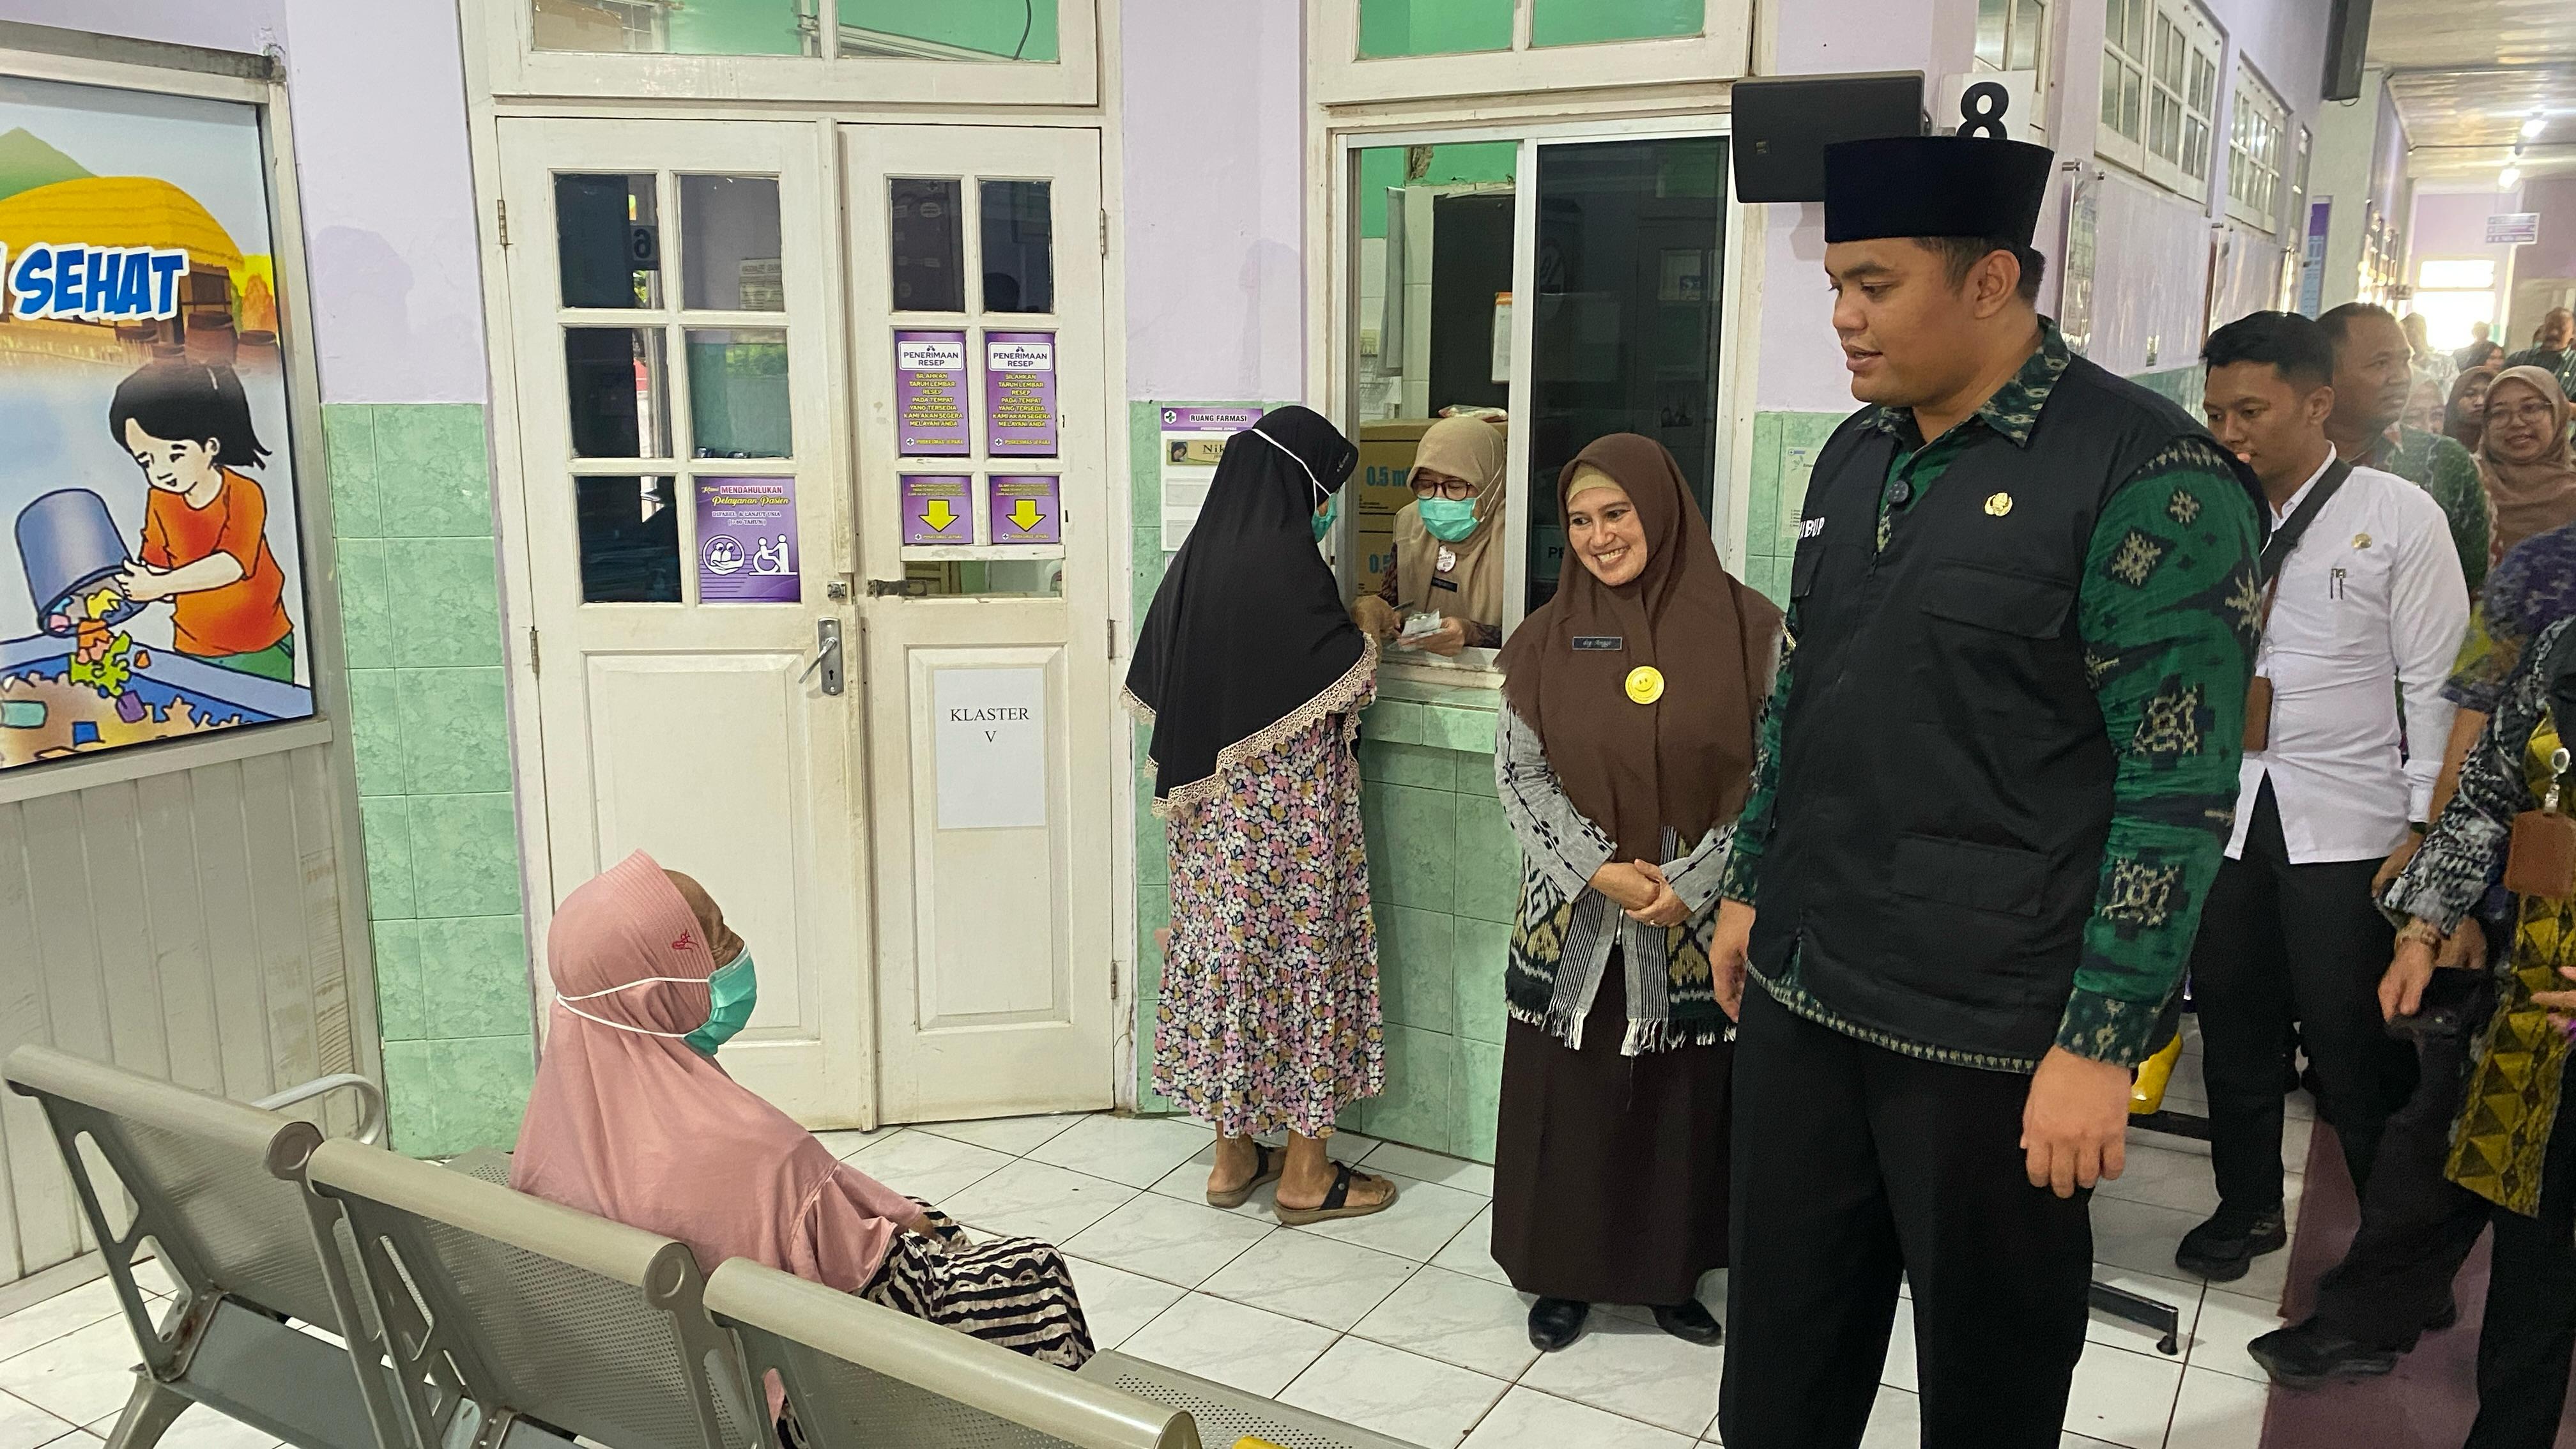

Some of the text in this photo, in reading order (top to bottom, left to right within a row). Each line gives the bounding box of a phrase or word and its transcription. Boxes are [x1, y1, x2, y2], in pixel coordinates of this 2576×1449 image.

[1956, 82, 2009, 139] 8
[14, 247, 184, 315] SEHAT
[1367, 466, 1388, 487] 0.5
[712, 496, 790, 507] Pelayanan Pasien
[950, 707, 1031, 722] KLASTER
[984, 730, 997, 743] V
